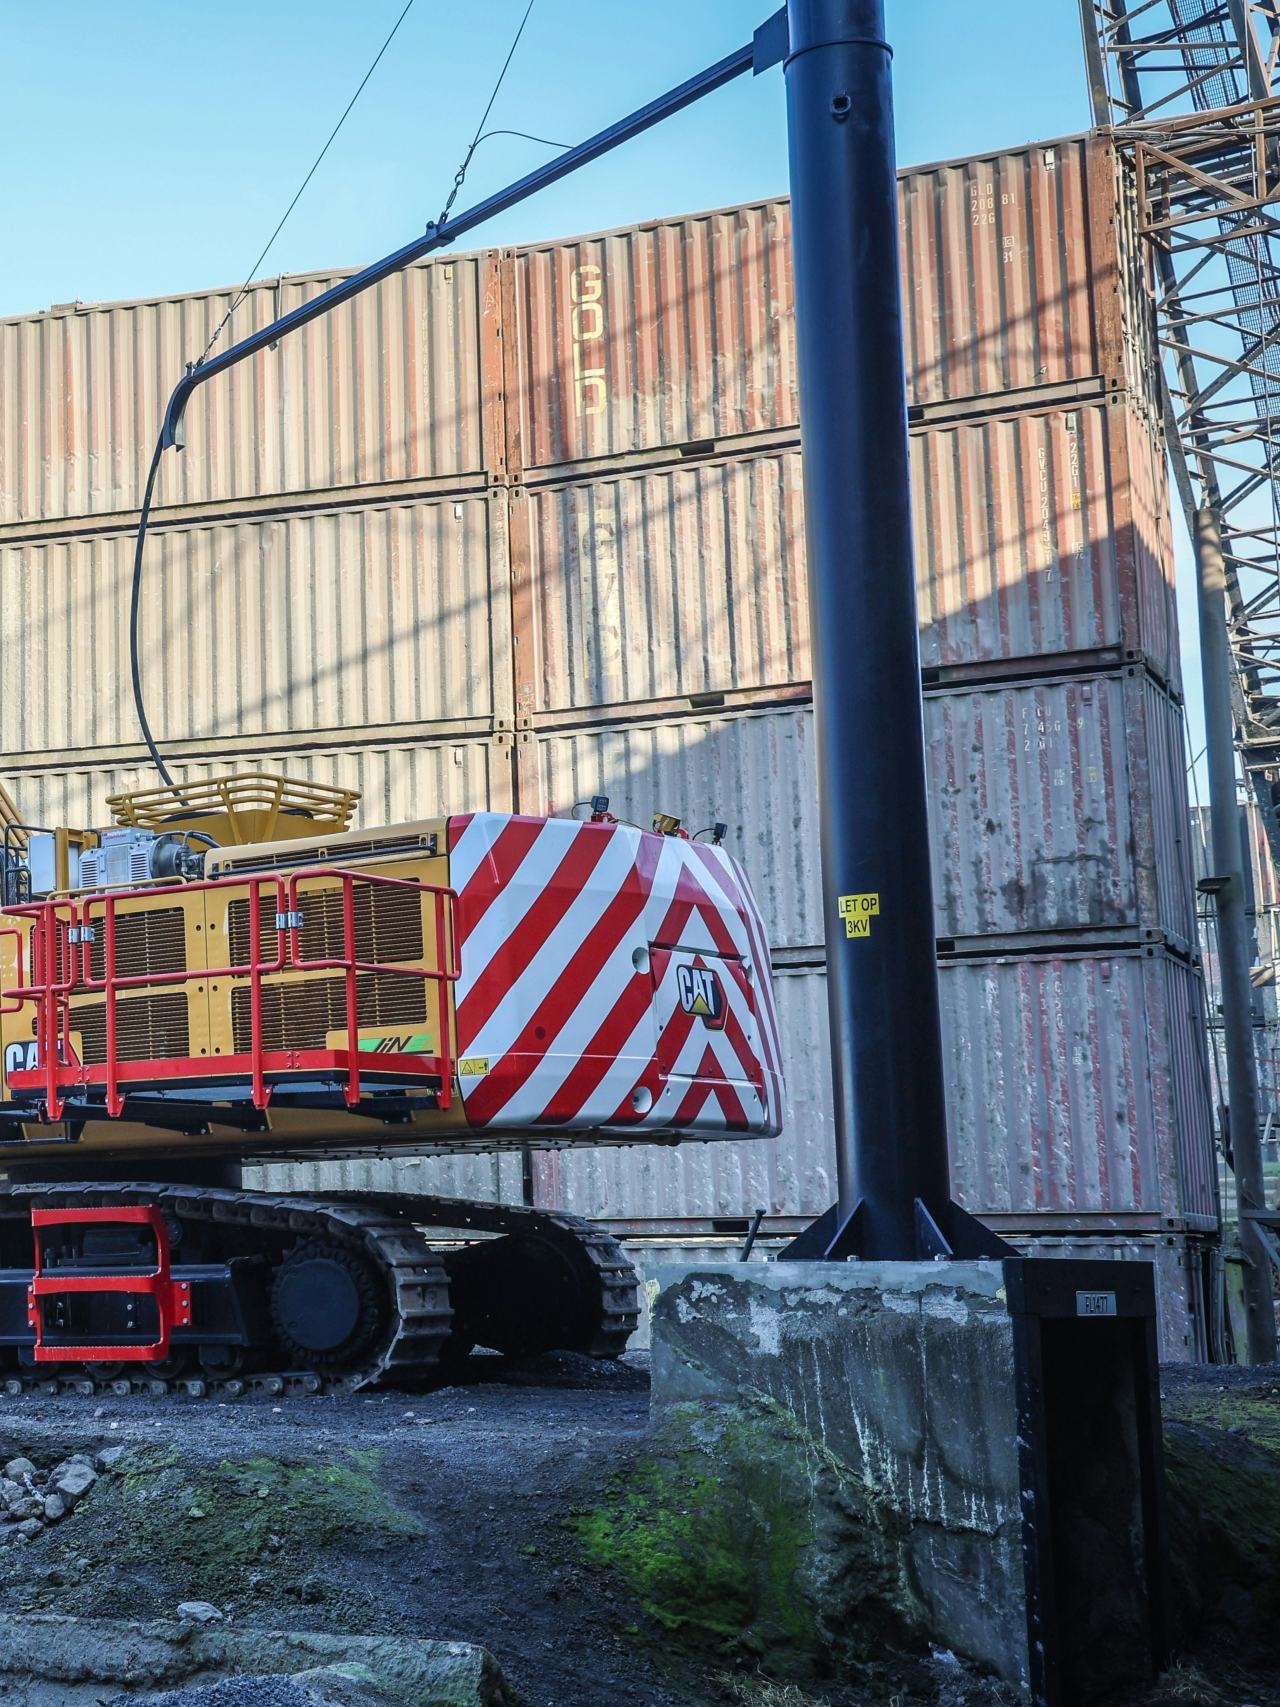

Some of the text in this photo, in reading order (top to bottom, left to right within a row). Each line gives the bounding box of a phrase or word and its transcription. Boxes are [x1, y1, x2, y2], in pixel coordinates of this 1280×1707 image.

[571, 264, 608, 417] GOLD
[1070, 442, 1079, 488] 22G1
[840, 897, 878, 914] LET OP
[847, 918, 869, 934] 3KV
[677, 965, 716, 1015] CAT
